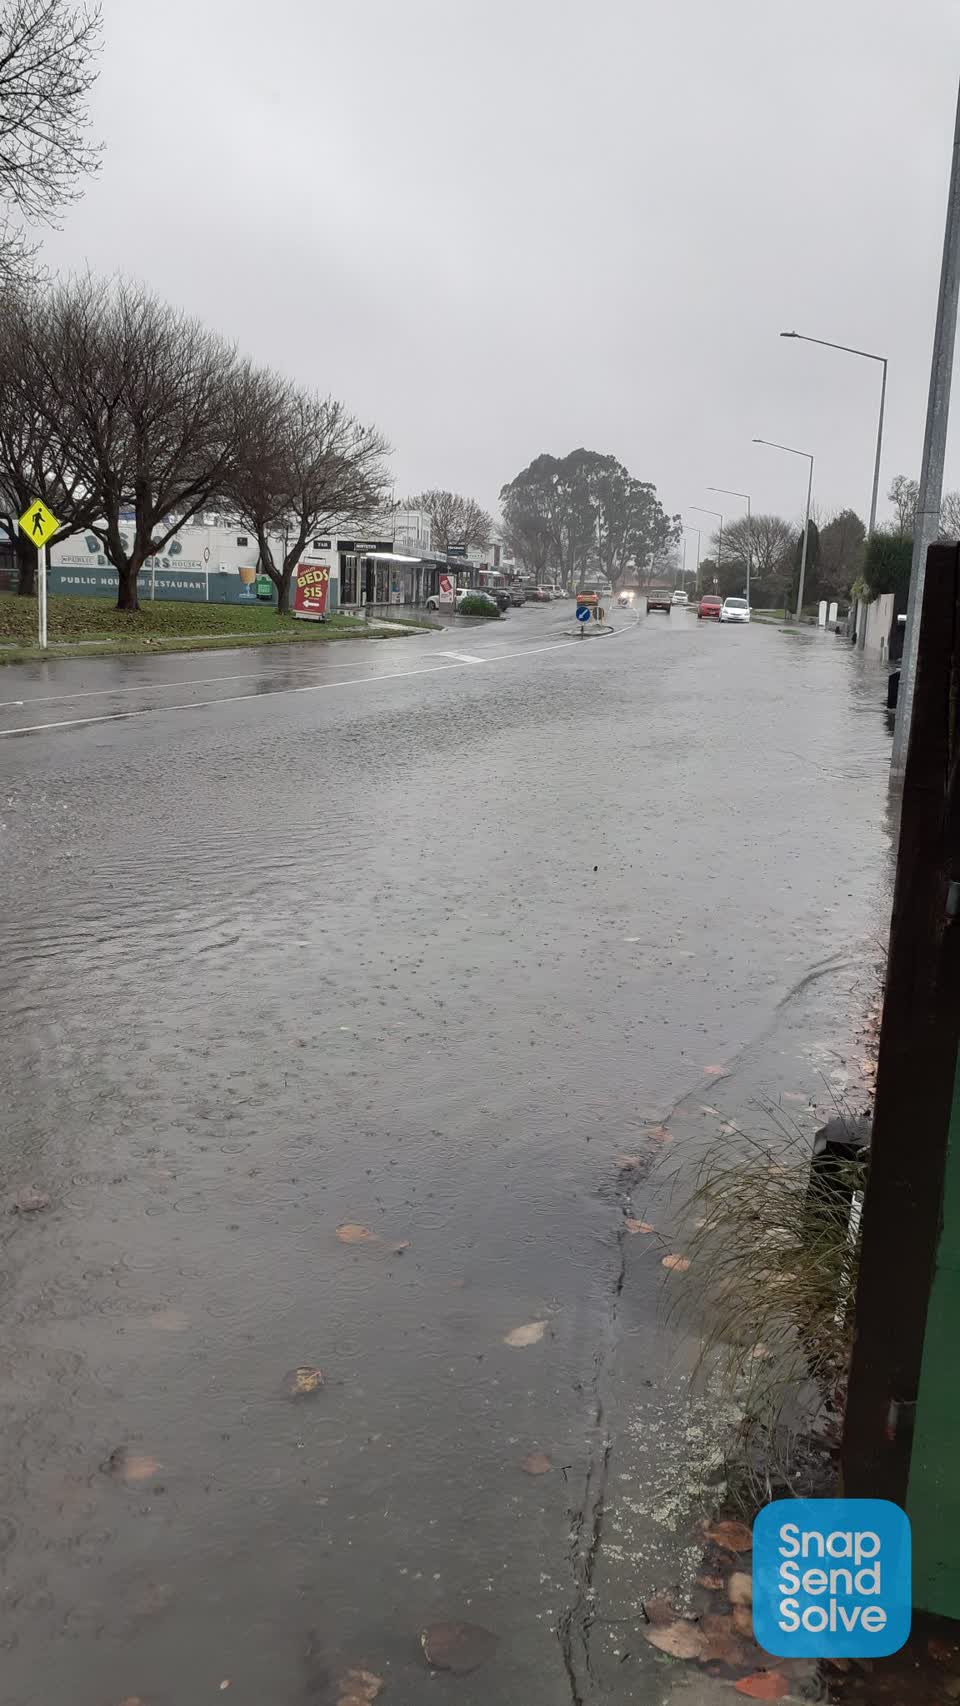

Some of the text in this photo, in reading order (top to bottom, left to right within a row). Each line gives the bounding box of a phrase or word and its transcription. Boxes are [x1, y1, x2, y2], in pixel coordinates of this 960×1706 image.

[61, 576, 96, 585] PUBLIC
[101, 578, 120, 586] HOU
[297, 568, 328, 588] BEDS
[303, 587, 323, 598] $15
